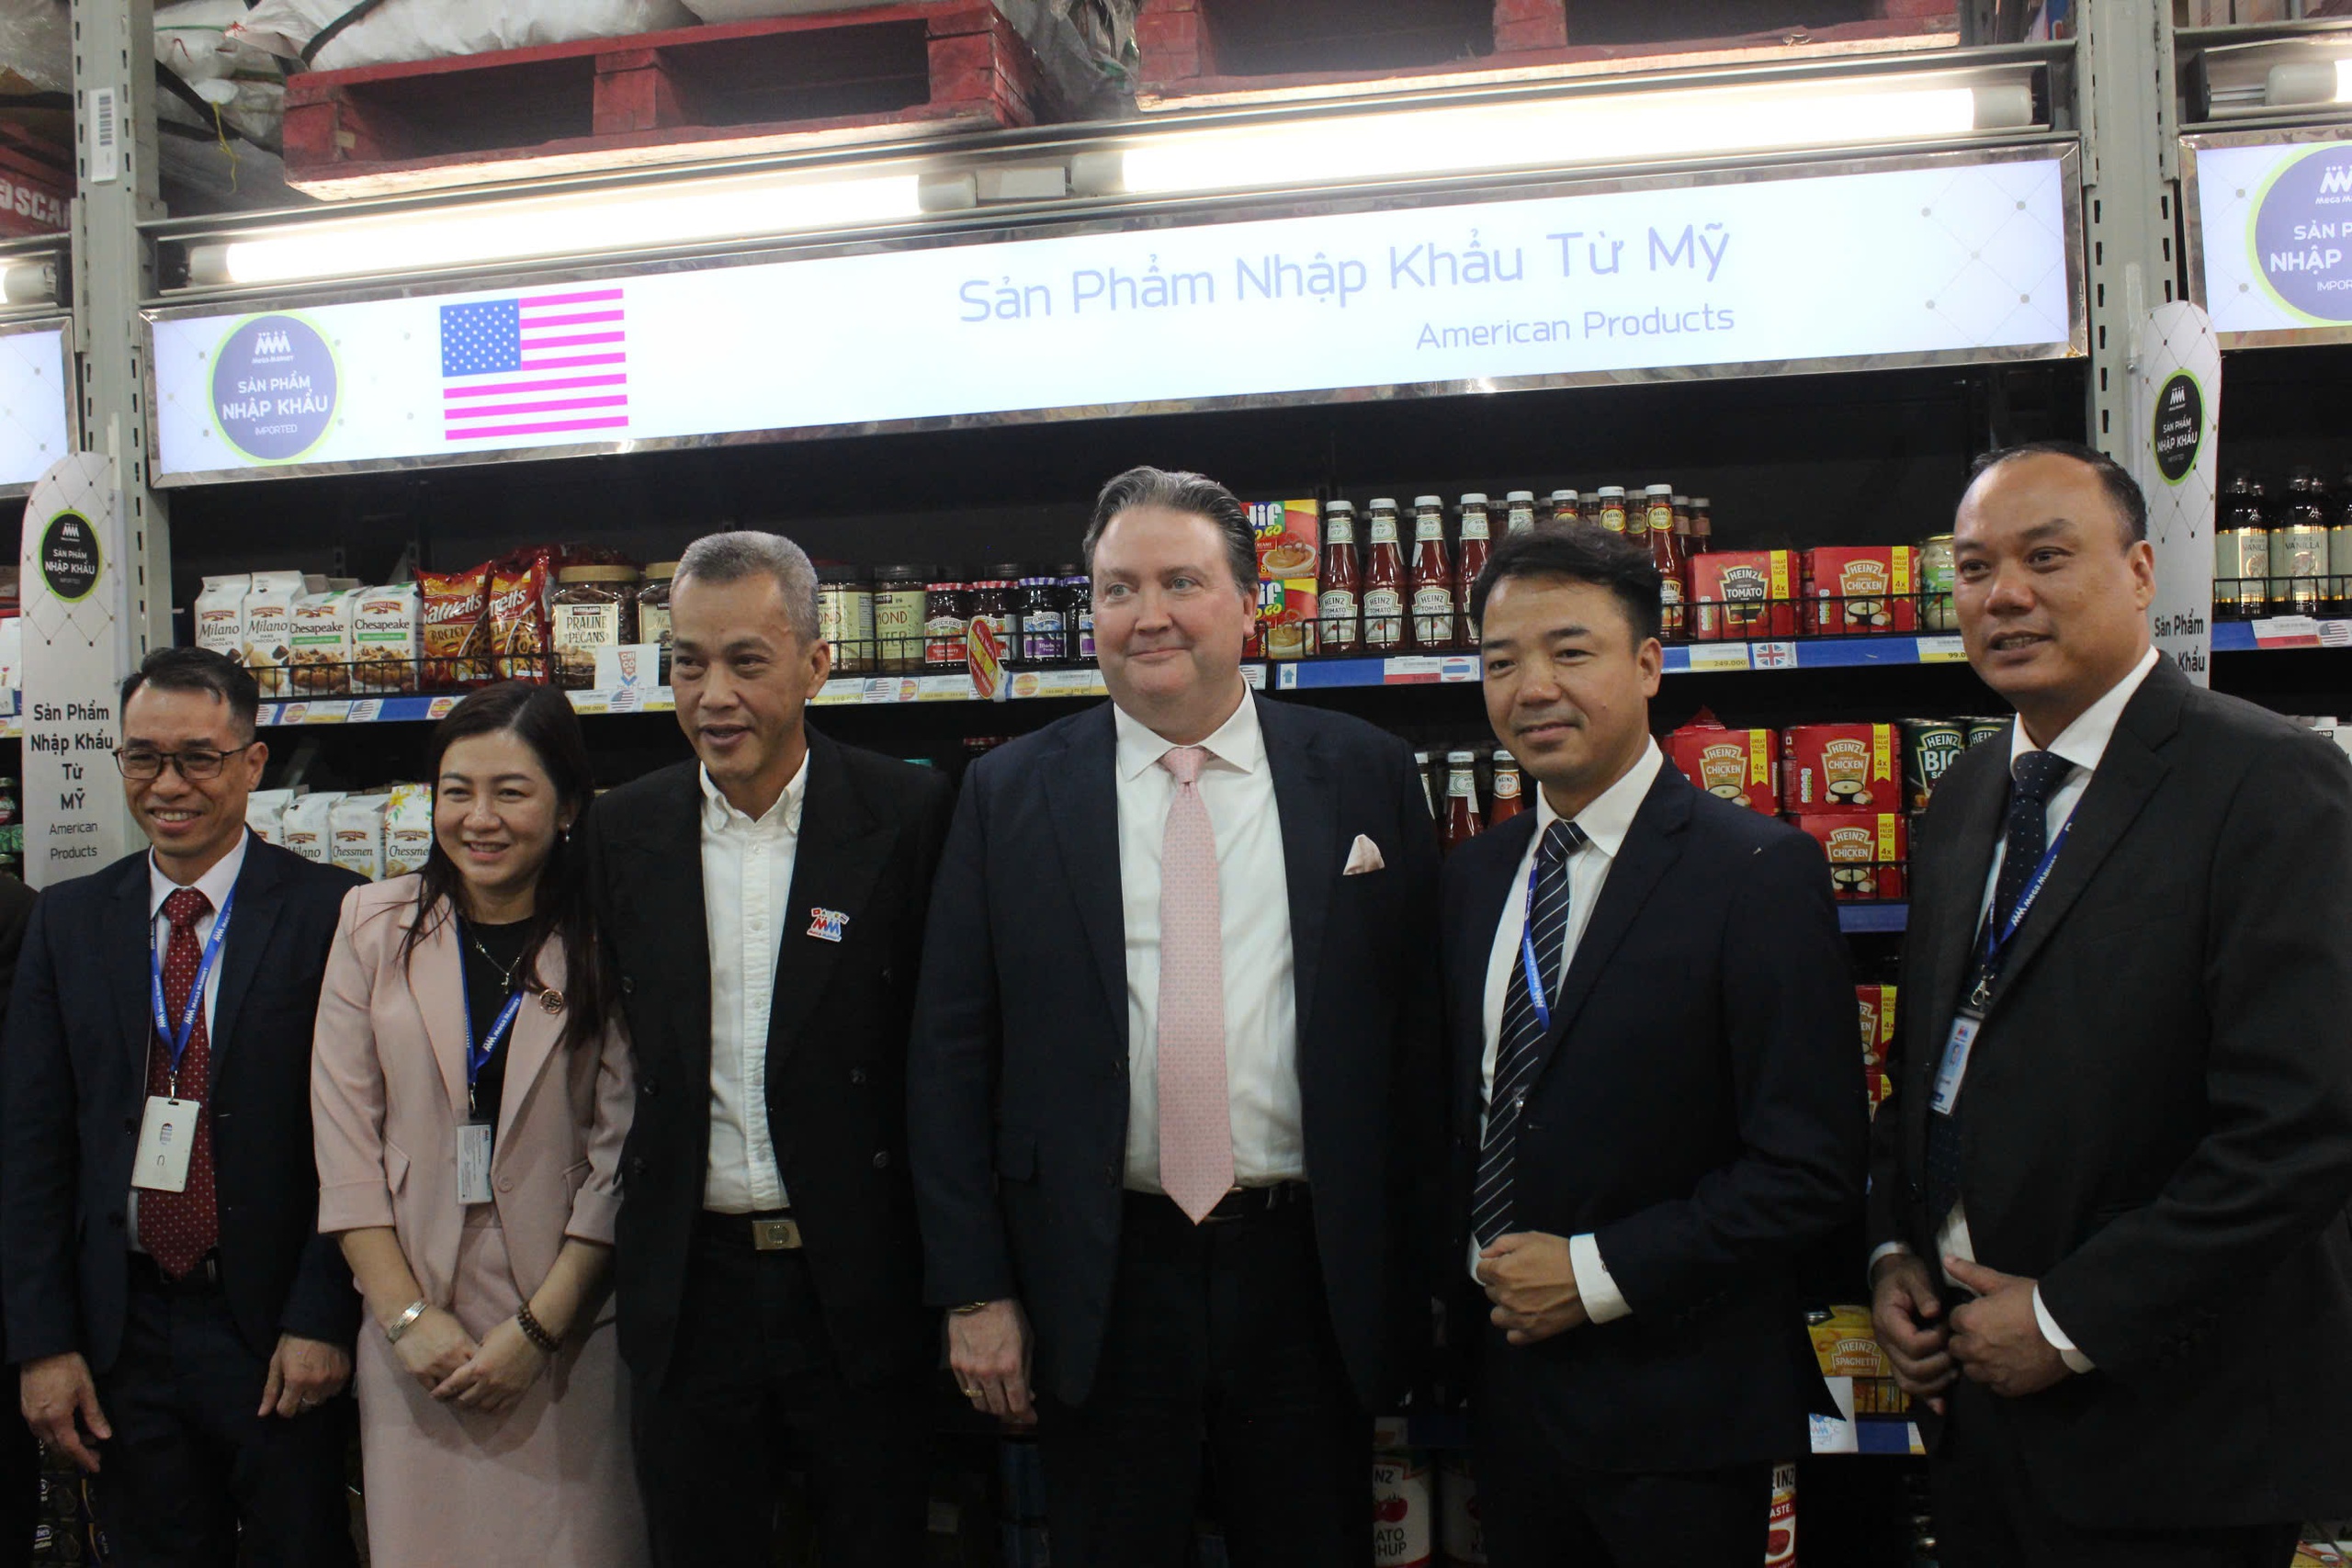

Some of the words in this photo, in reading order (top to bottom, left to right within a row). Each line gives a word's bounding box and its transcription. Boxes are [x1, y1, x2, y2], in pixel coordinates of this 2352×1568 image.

[2293, 220, 2335, 240] SẢN
[2270, 244, 2342, 275] NHẬP
[959, 276, 1051, 322] Sản
[1072, 254, 1214, 313] Phẩm
[1236, 252, 1366, 308] Nhập
[1389, 229, 1523, 289] Khẩu
[1546, 231, 1623, 277] Từ
[1648, 223, 1729, 282] Mỹ
[2317, 279, 2352, 290] IMPOR
[1416, 320, 1570, 350] American
[1584, 303, 1735, 339] Products
[238, 376, 266, 393] SẢN
[270, 370, 311, 391] PHẨM
[222, 397, 272, 422] NHẬP
[277, 388, 328, 415] KHẨU
[255, 424, 298, 435] IMPORTED
[2285, 542, 2320, 550] VANILLA
[1729, 570, 1758, 581] HEINZ
[1850, 564, 1879, 574] HEINZ
[1662, 583, 1679, 592] EINZ
[1847, 581, 1882, 590] CHICKEN
[1259, 582, 1282, 605] if
[1726, 588, 1762, 598] TOMATO
[1325, 597, 1345, 606] HEINZ
[1369, 597, 1390, 606] HEINZ
[567, 616, 606, 630] PRALINE
[876, 611, 908, 625] MOND
[2154, 615, 2171, 637] Sản
[2175, 608, 2203, 636] Phẩm
[198, 624, 240, 638] Milano
[246, 620, 288, 636] Milano
[289, 622, 345, 635] Chesapeake
[355, 619, 411, 631] Chesapeake
[569, 631, 605, 643] PECANS
[2178, 646, 2205, 672] Khẩu
[34, 704, 62, 721] Sản
[67, 700, 109, 721] Phẩm
[31, 733, 69, 756] Nhập
[75, 728, 114, 750] Khẩu
[1928, 735, 1959, 748] HEINZ
[1972, 732, 1992, 744] HEI
[1709, 749, 1737, 759] HEINZ
[1832, 744, 1860, 753] HEINZ
[62, 763, 84, 780] Từ
[1706, 765, 1741, 774] CHICKEN
[1828, 761, 1863, 769] CHICKEN
[49, 822, 98, 836] American
[1837, 832, 1863, 841] HEINZ
[50, 845, 97, 860] Products
[333, 845, 373, 857] Chessmen
[389, 845, 428, 858] Chessme
[1833, 849, 1868, 857] CHICKEN
[1841, 1342, 1871, 1351] HEINZ
[1836, 1357, 1878, 1366] SPAGHETTI
[1770, 1504, 1791, 1517] ASTE
[1376, 1528, 1404, 1541] ATO
